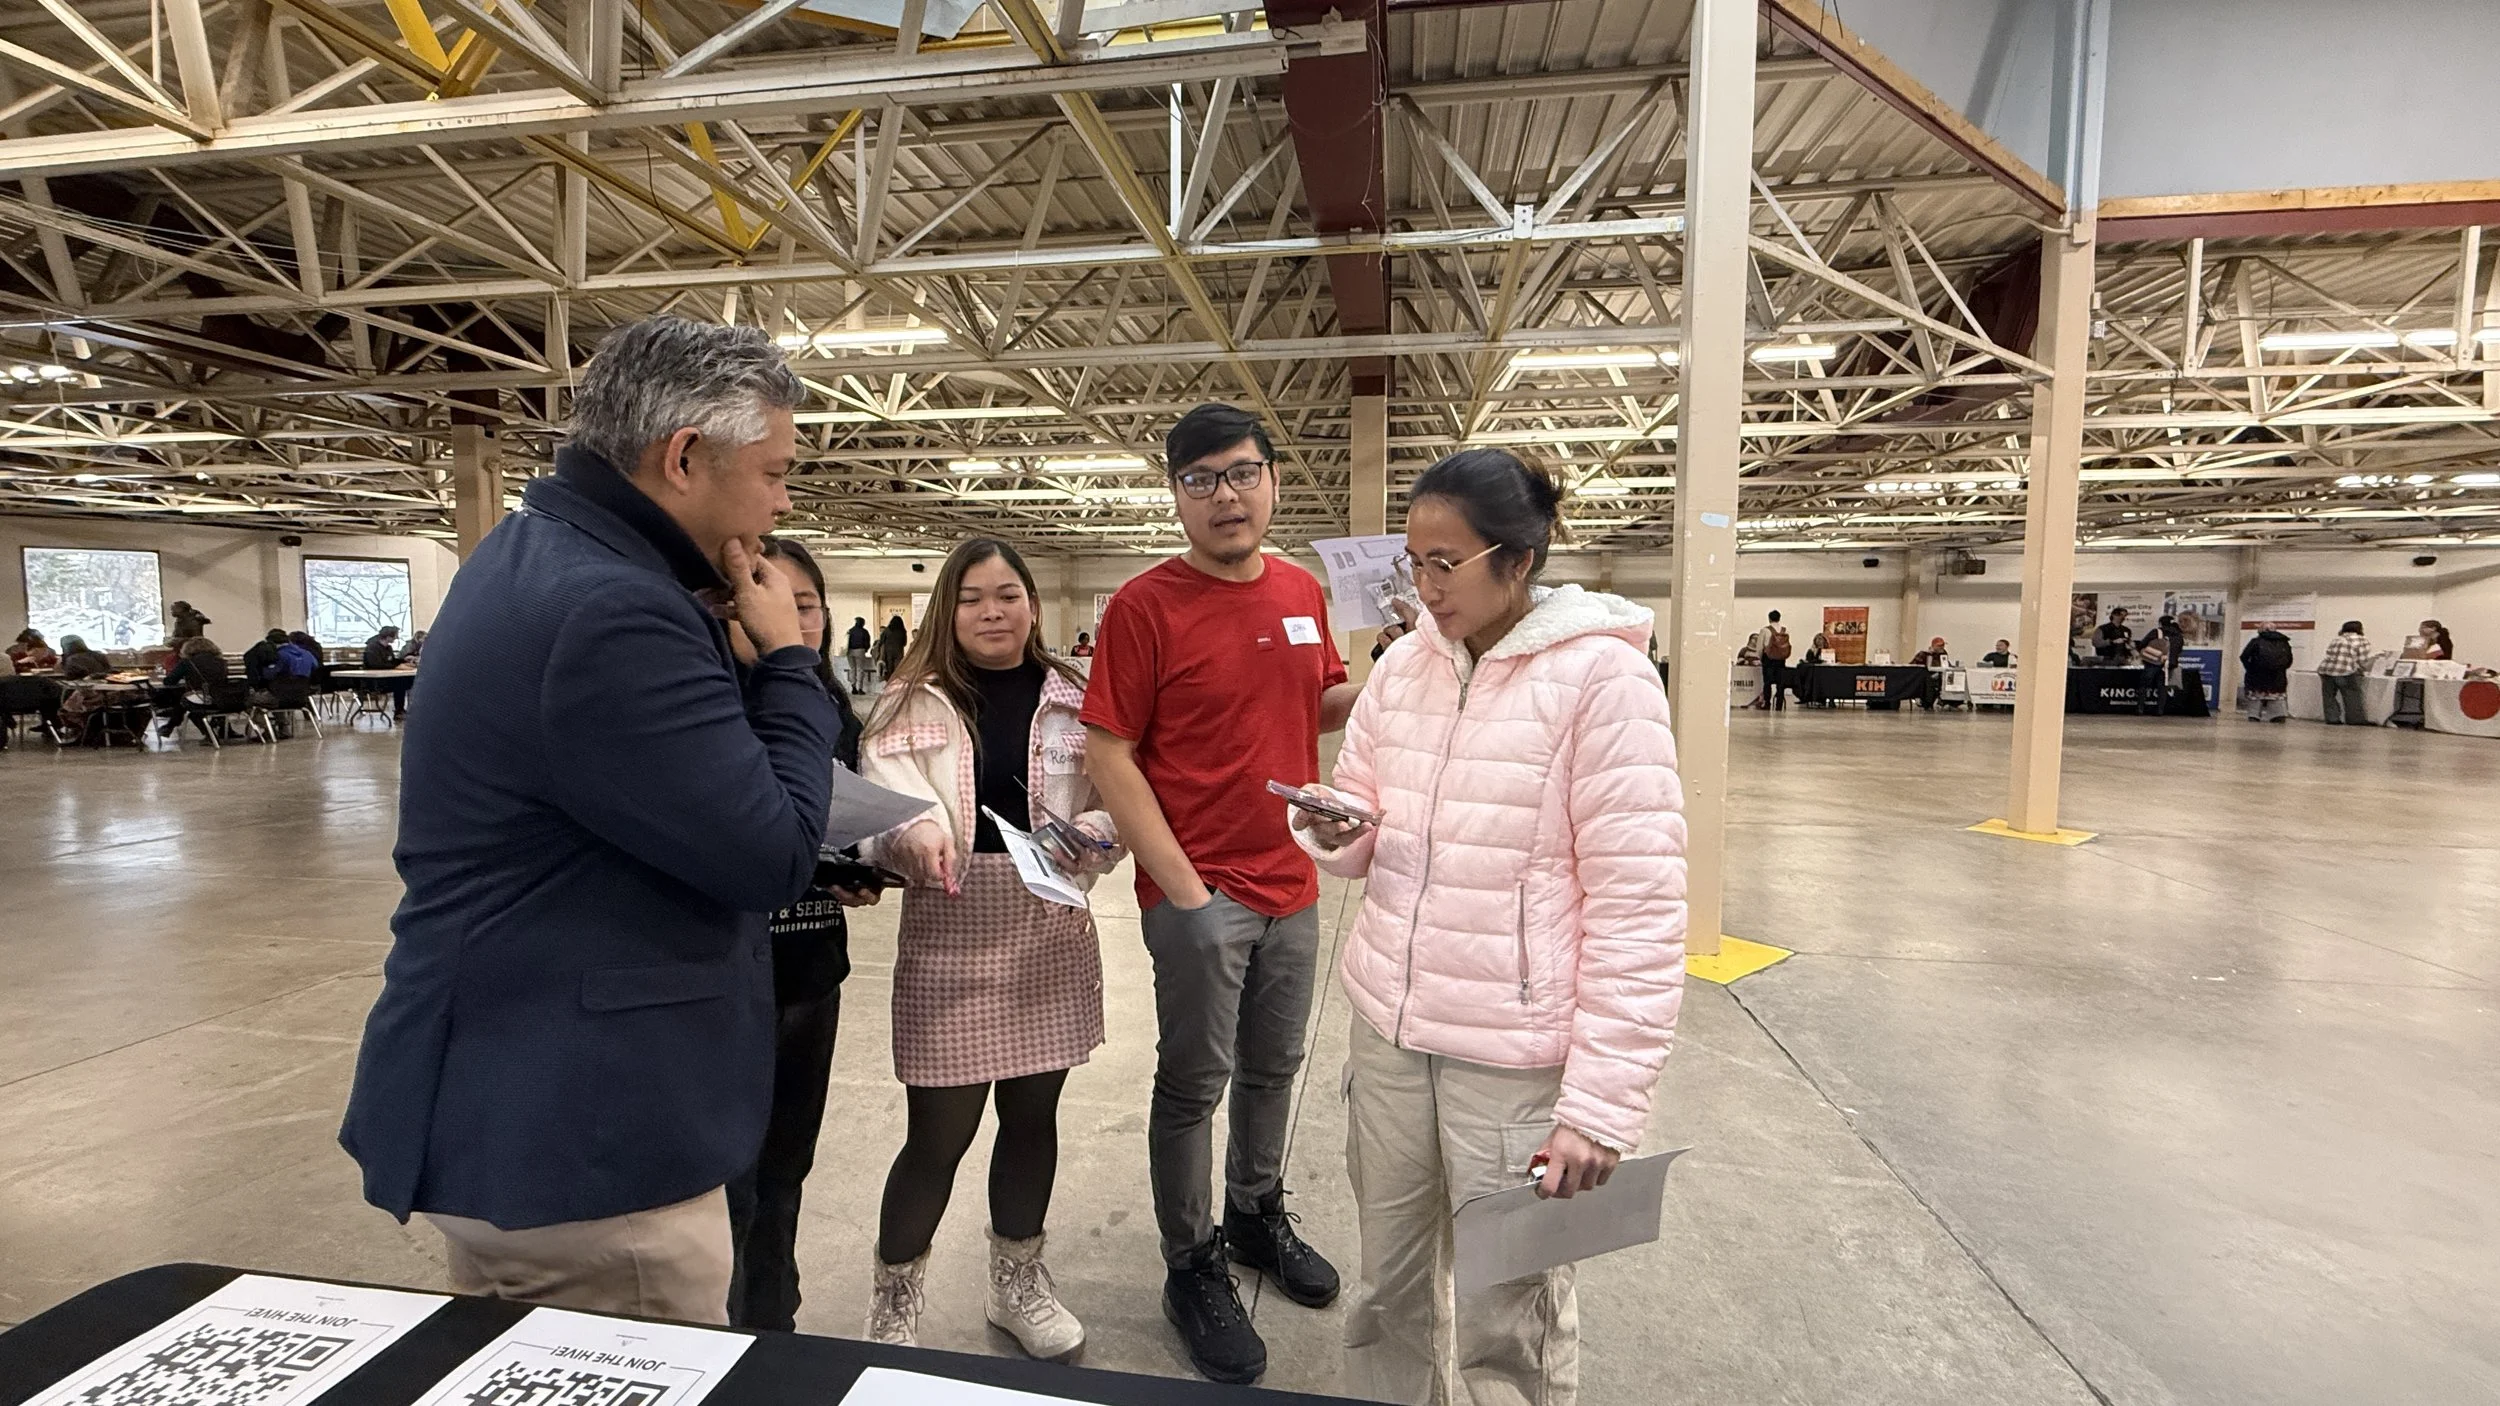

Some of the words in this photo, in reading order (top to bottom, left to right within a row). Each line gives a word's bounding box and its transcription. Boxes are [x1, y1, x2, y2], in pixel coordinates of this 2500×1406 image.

[2100, 687, 2175, 698] KINGTN
[796, 900, 842, 917] SERIES
[244, 1308, 290, 1320] HIVE!
[285, 1312, 319, 1324] THE
[315, 1315, 358, 1327] JOIN
[550, 1345, 595, 1361] HIVE!
[592, 1352, 625, 1366] THE
[623, 1357, 667, 1371] JOIN
